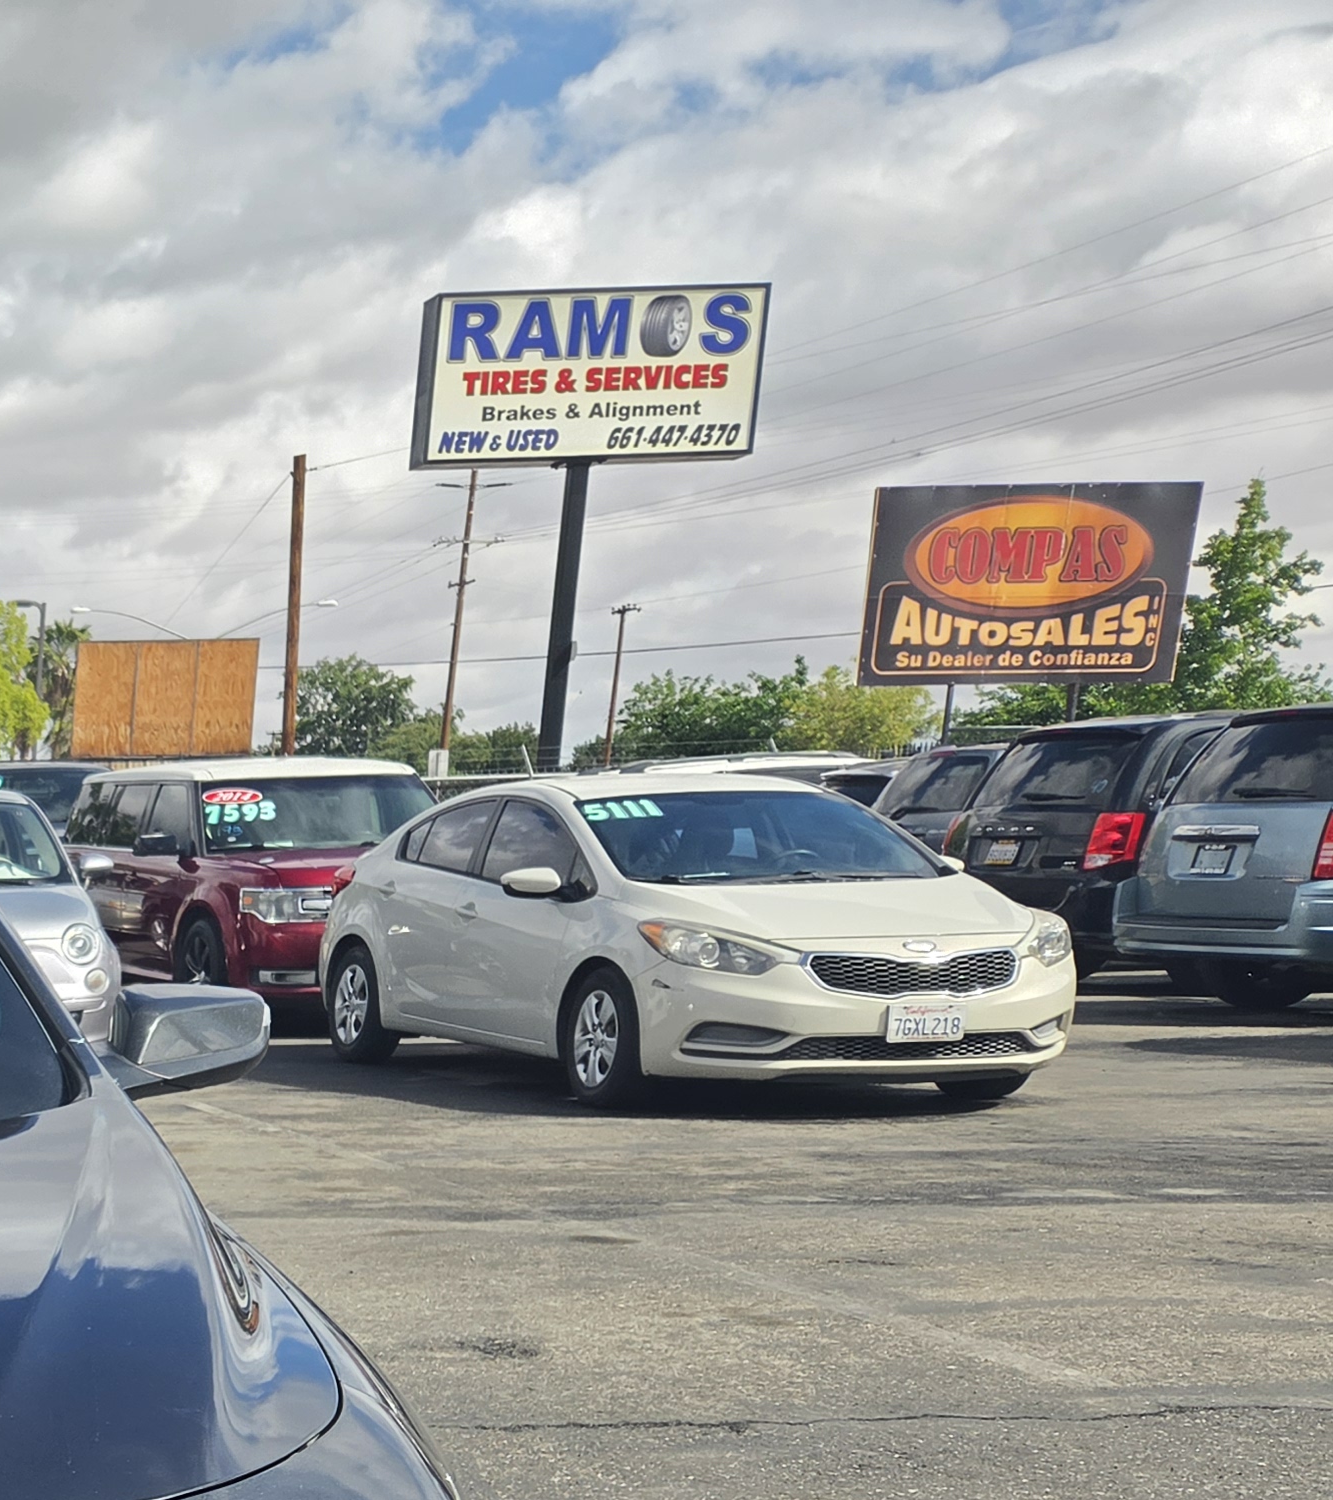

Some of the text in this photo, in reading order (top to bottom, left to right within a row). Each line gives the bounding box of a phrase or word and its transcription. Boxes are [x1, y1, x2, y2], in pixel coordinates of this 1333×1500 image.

[463, 364, 729, 397] TIRES & SERVICES
[482, 400, 702, 422] Brakes & Alignment
[438, 428, 559, 454] NEW & USED
[928, 525, 1128, 584] COMPAS
[890, 595, 1150, 647] AUTOSALES
[895, 650, 1133, 668] Su Dealer de Confianza
[216, 791, 254, 802] 2014
[204, 800, 276, 825] 7593
[583, 799, 664, 821] 5111
[894, 1017, 961, 1037] 7GXL218
